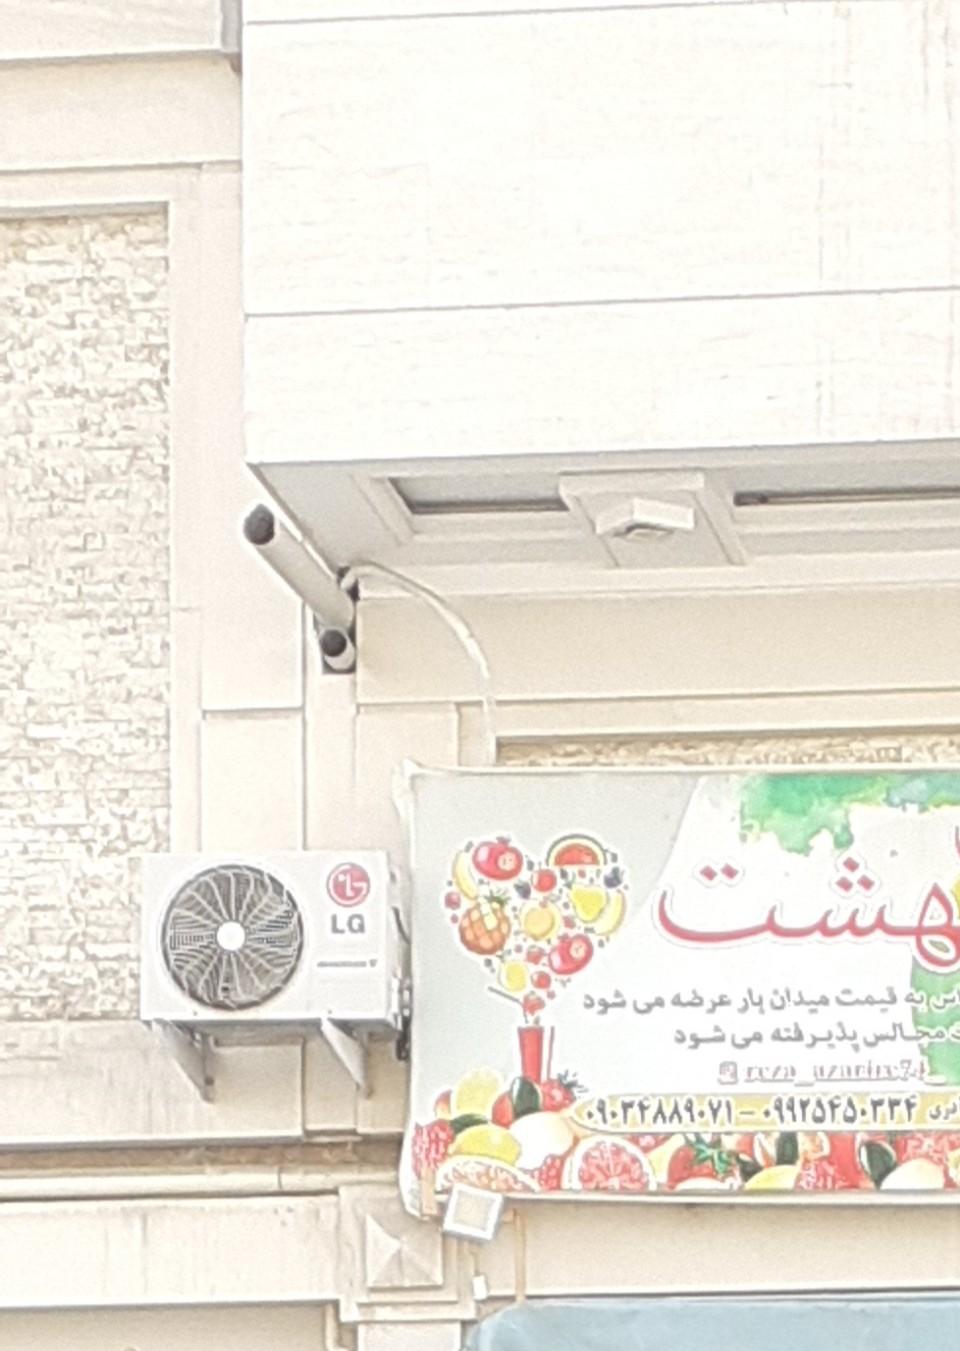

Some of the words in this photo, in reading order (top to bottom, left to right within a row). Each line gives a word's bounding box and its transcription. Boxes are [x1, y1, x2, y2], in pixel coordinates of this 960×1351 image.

[331, 914, 366, 934] LG
[583, 988, 627, 1016] شود
[632, 993, 666, 1015] می
[671, 989, 732, 1014] عرضه
[769, 986, 830, 1014] میدان
[835, 986, 898, 1013] قیمت
[674, 1024, 727, 1050] شود
[731, 1030, 764, 1050] می
[770, 1021, 860, 1054] پذیرفته
[863, 1022, 946, 1052] مجالس
